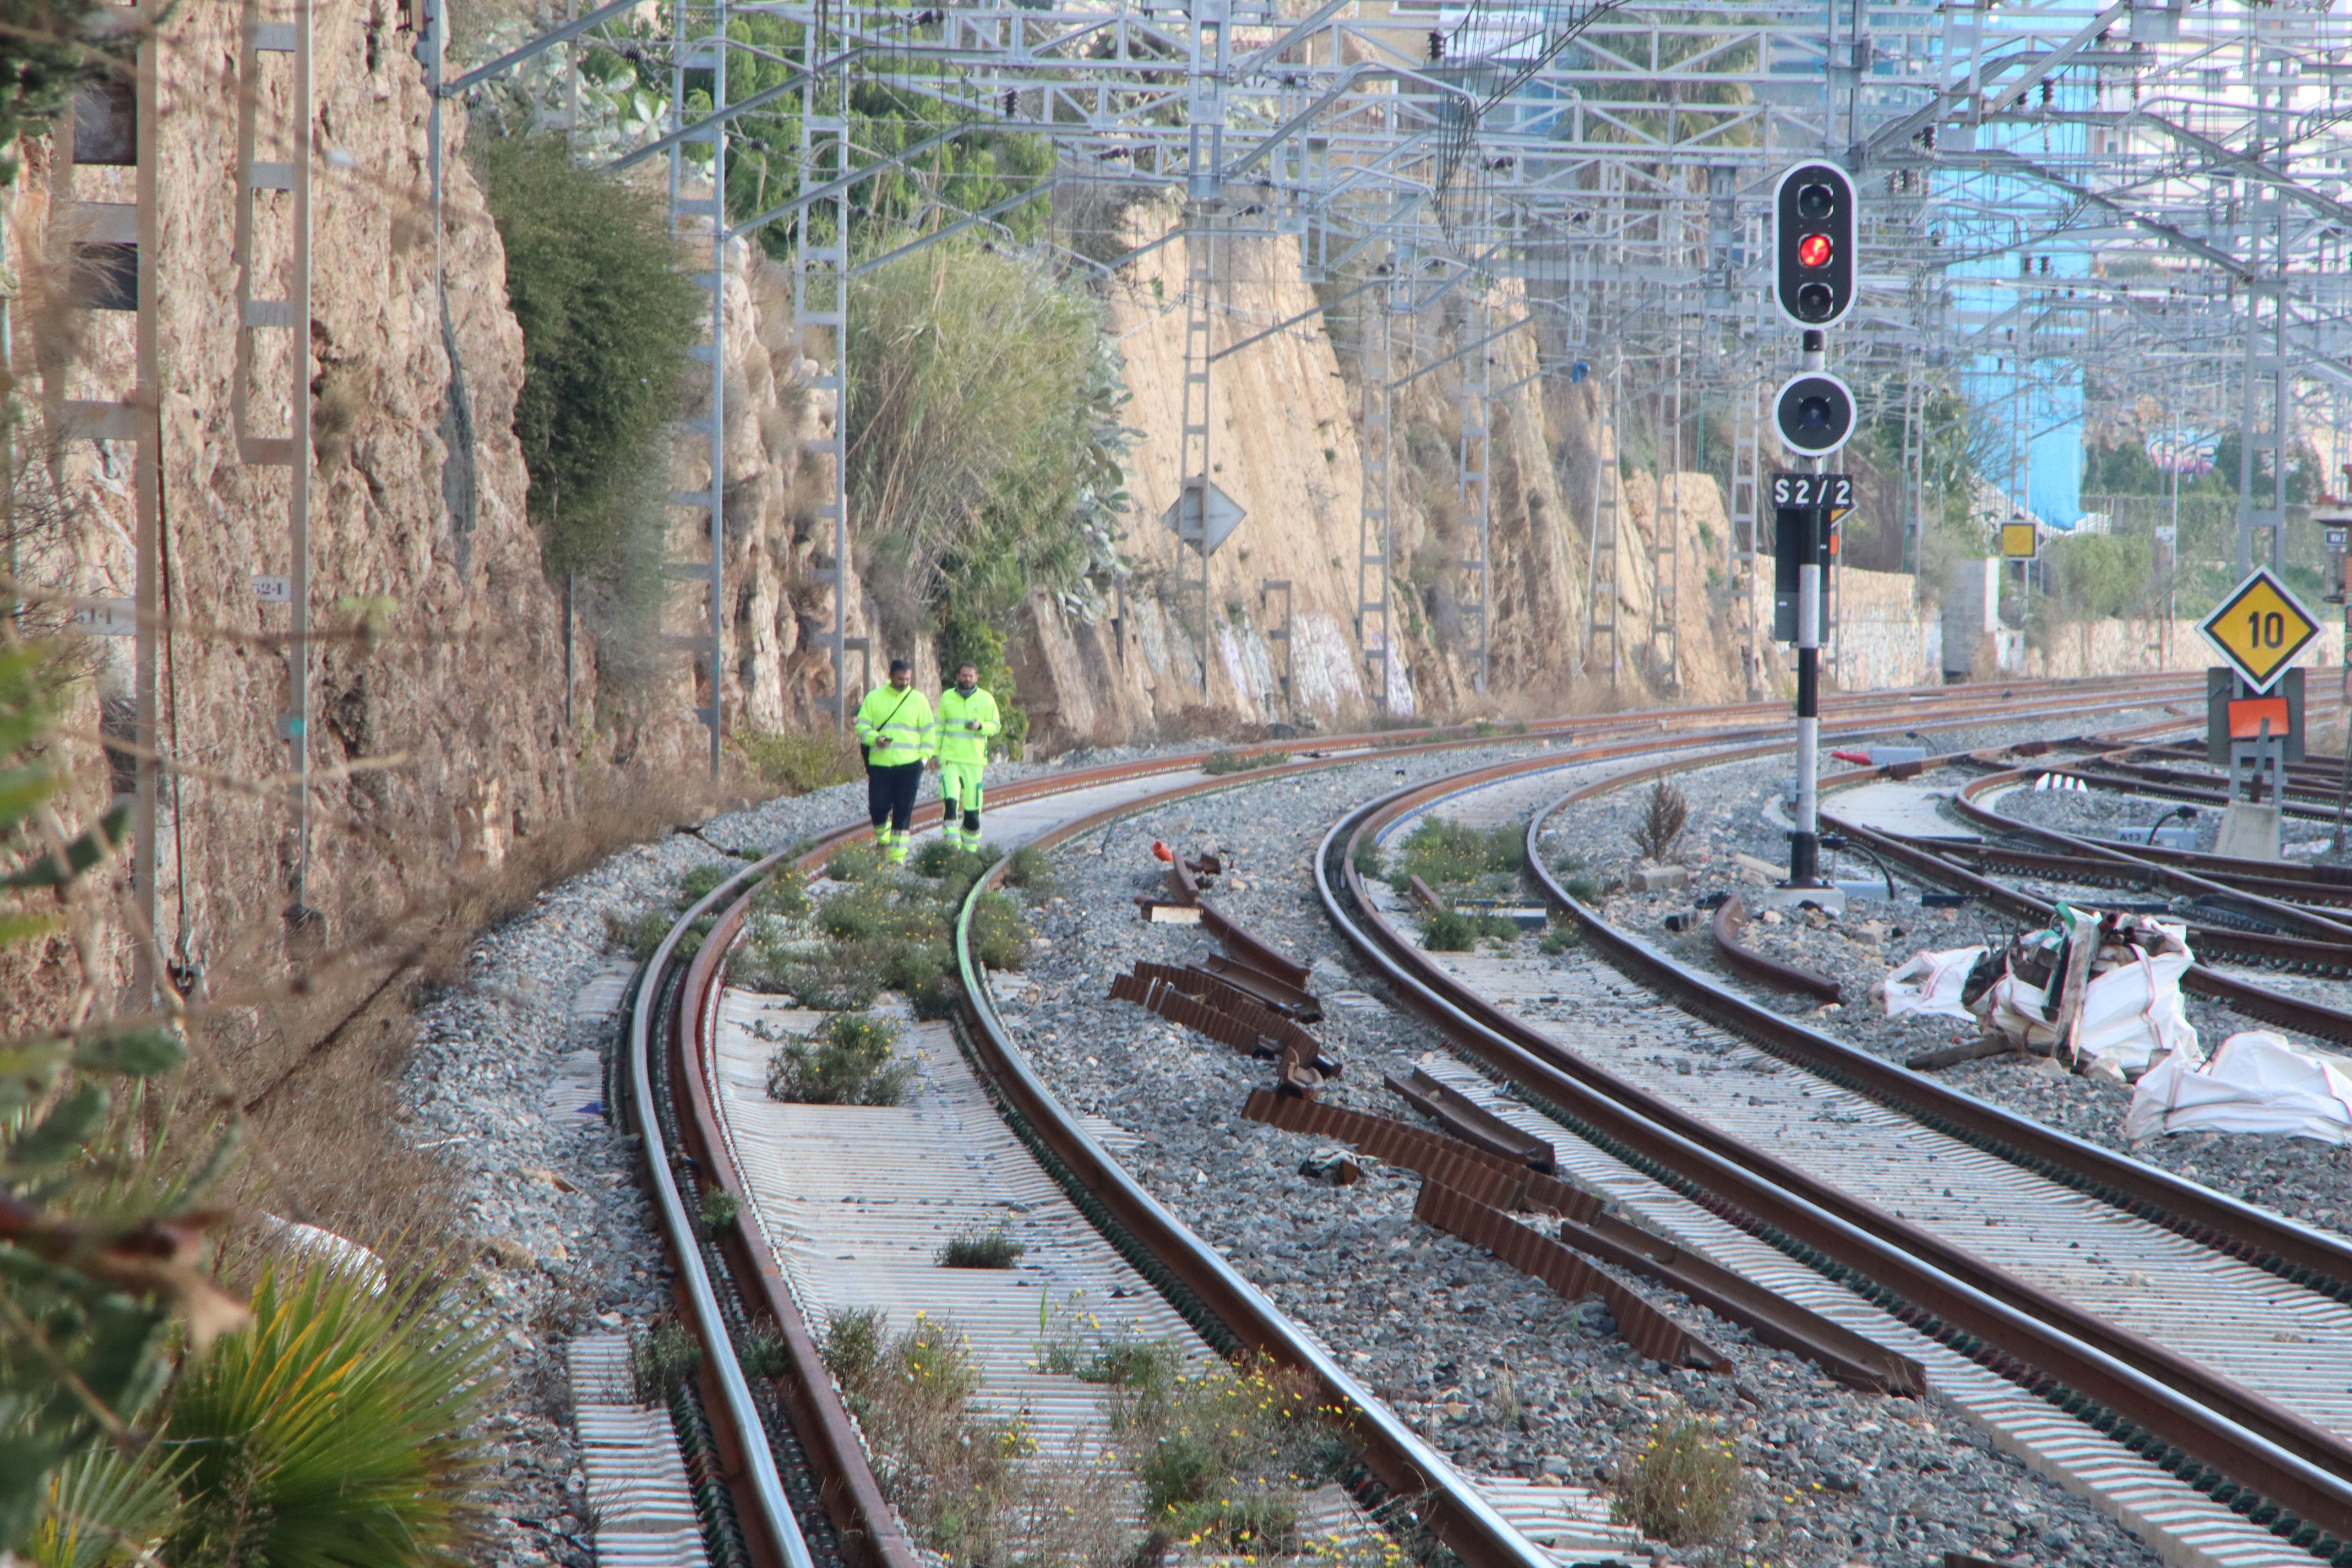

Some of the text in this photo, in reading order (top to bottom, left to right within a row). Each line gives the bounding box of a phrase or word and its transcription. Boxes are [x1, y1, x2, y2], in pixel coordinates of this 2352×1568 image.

[1774, 478, 1850, 505] S2/2
[2247, 611, 2284, 649] 10
[2120, 832, 2142, 842] A13
